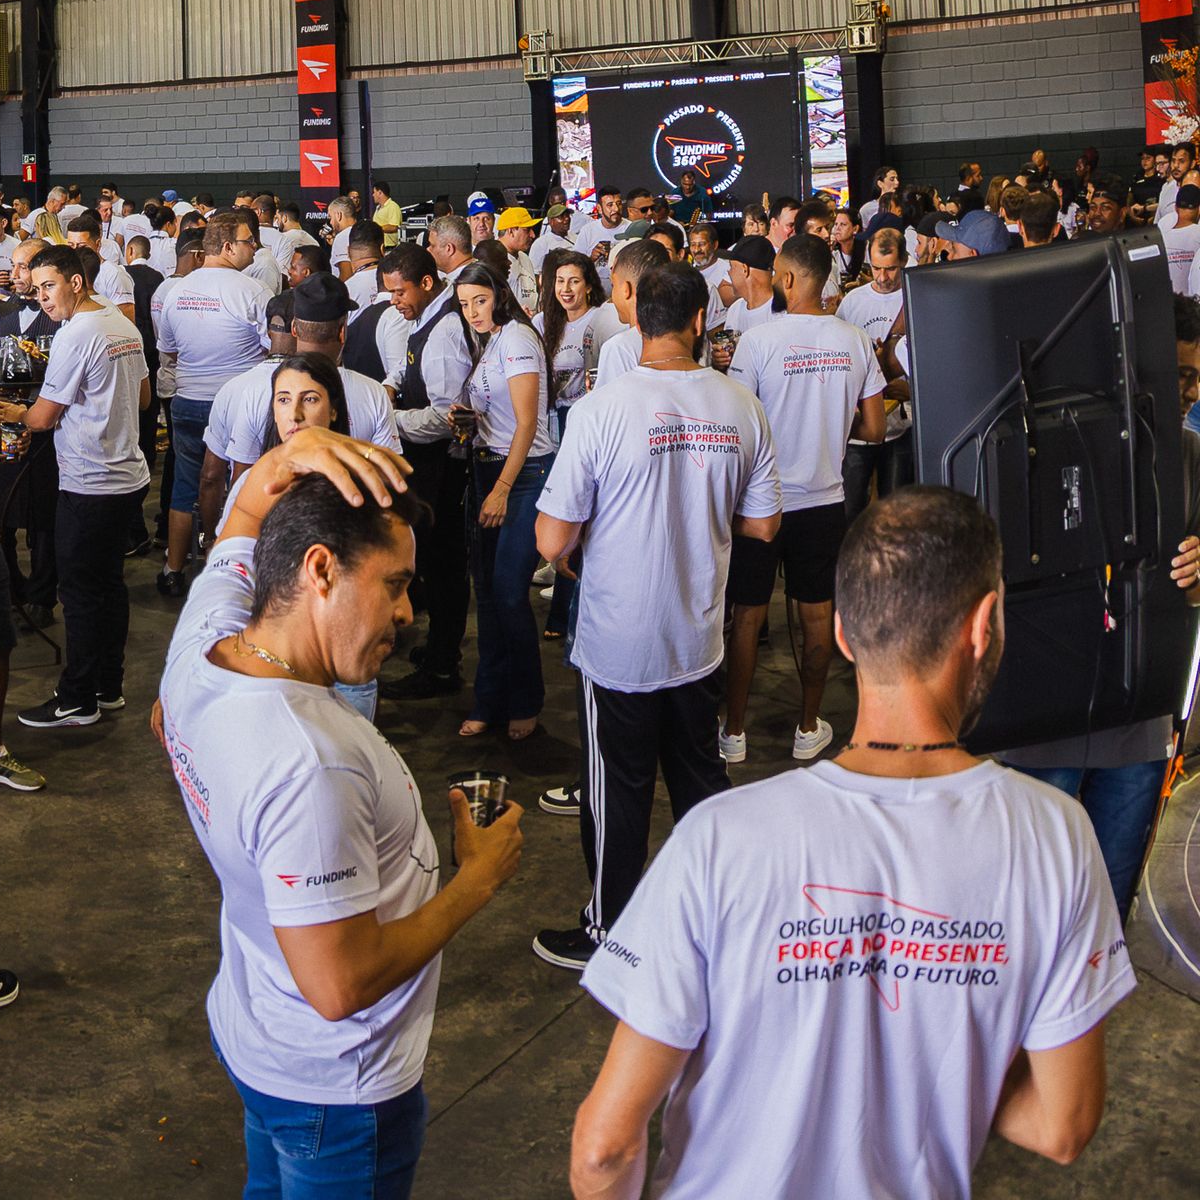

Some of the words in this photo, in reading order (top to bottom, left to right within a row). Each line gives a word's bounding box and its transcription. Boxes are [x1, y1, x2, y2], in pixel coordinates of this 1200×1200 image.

[300, 23, 329, 33] FUNDIMIG
[671, 78, 698, 86] PASSADO
[704, 75, 734, 83] PRESENTE
[740, 72, 765, 81] FUTURO
[663, 104, 705, 127] PASSADO
[303, 118, 332, 127] FUNDIMIG
[716, 110, 746, 151] PRESENTE
[672, 143, 726, 157] FUNDIMIG
[672, 155, 702, 168] 360°
[712, 164, 743, 195] FUTURO
[863, 316, 888, 329] PASSADO
[783, 353, 812, 362] ORGULHO
[784, 361, 807, 369] FORÇA
[807, 359, 818, 367] NO
[783, 368, 804, 377] OLHAR
[804, 366, 820, 374] PARA
[648, 424, 686, 436] ORGULHO
[687, 424, 700, 432] DO
[702, 424, 739, 435] PASSADO,
[649, 434, 678, 446] FORÇA
[679, 433, 693, 441] NO
[649, 445, 675, 456] OLHAR
[675, 443, 697, 452] PARA
[699, 444, 706, 452] O
[707, 444, 740, 454] FUTURO.
[306, 866, 358, 888] FUNDIMIG
[779, 912, 879, 940] ORGULHO
[878, 912, 905, 935] DO
[910, 919, 1006, 942] PASSADO,
[777, 938, 853, 965] FORÇA
[861, 933, 887, 954] NO
[890, 940, 1010, 965] PRESENTE,
[777, 962, 844, 984] OLHAR
[847, 956, 888, 977] PARA
[894, 964, 909, 979] O
[913, 966, 999, 986] FUTURO.
